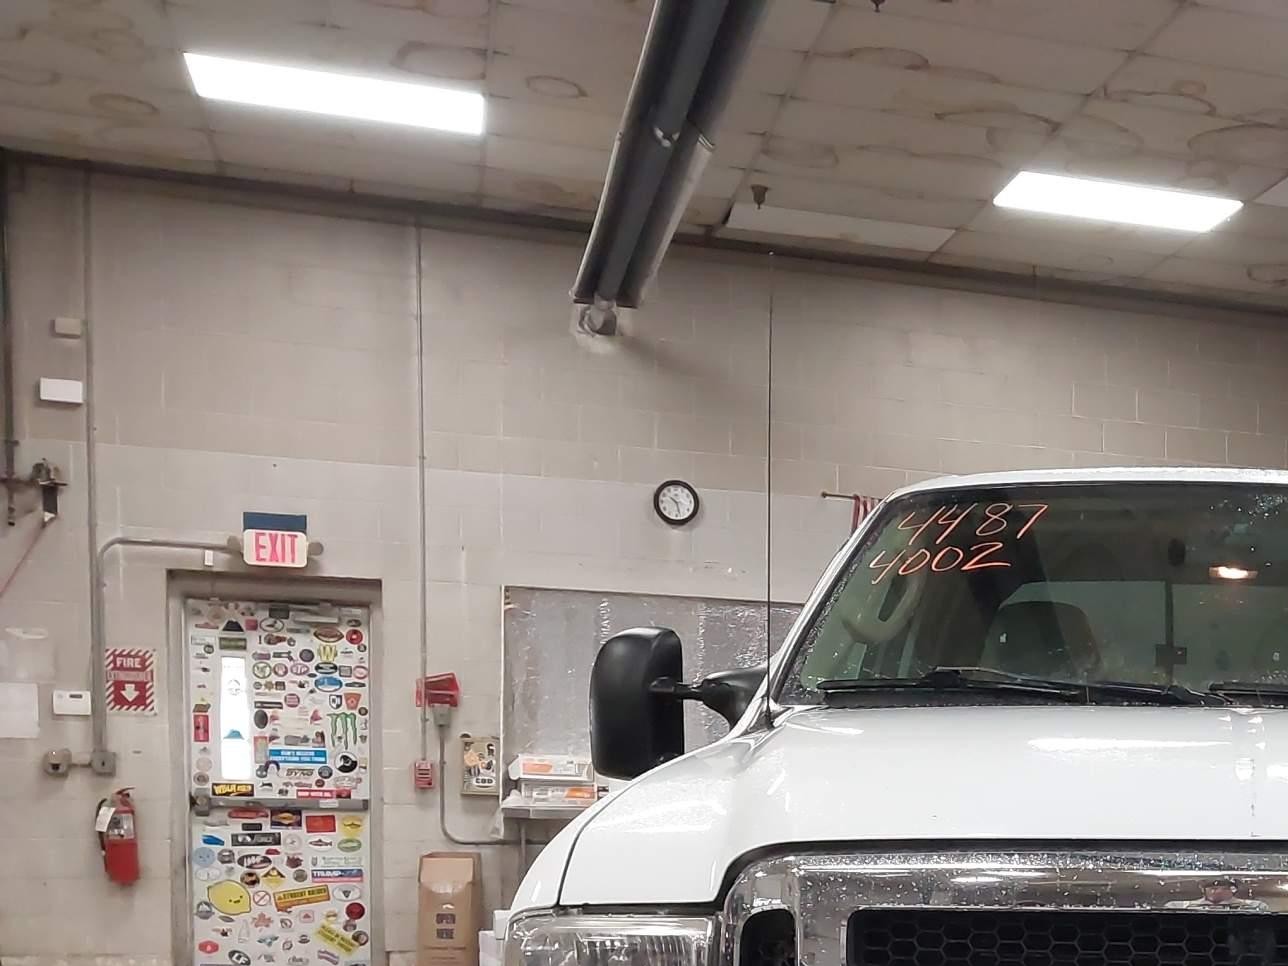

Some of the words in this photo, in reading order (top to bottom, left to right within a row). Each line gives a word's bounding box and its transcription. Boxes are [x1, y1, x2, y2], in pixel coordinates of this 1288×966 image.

[897, 502, 1049, 546] 4487
[254, 532, 299, 563] EXIT
[869, 541, 1012, 585] 4002
[116, 657, 142, 668] FIRE
